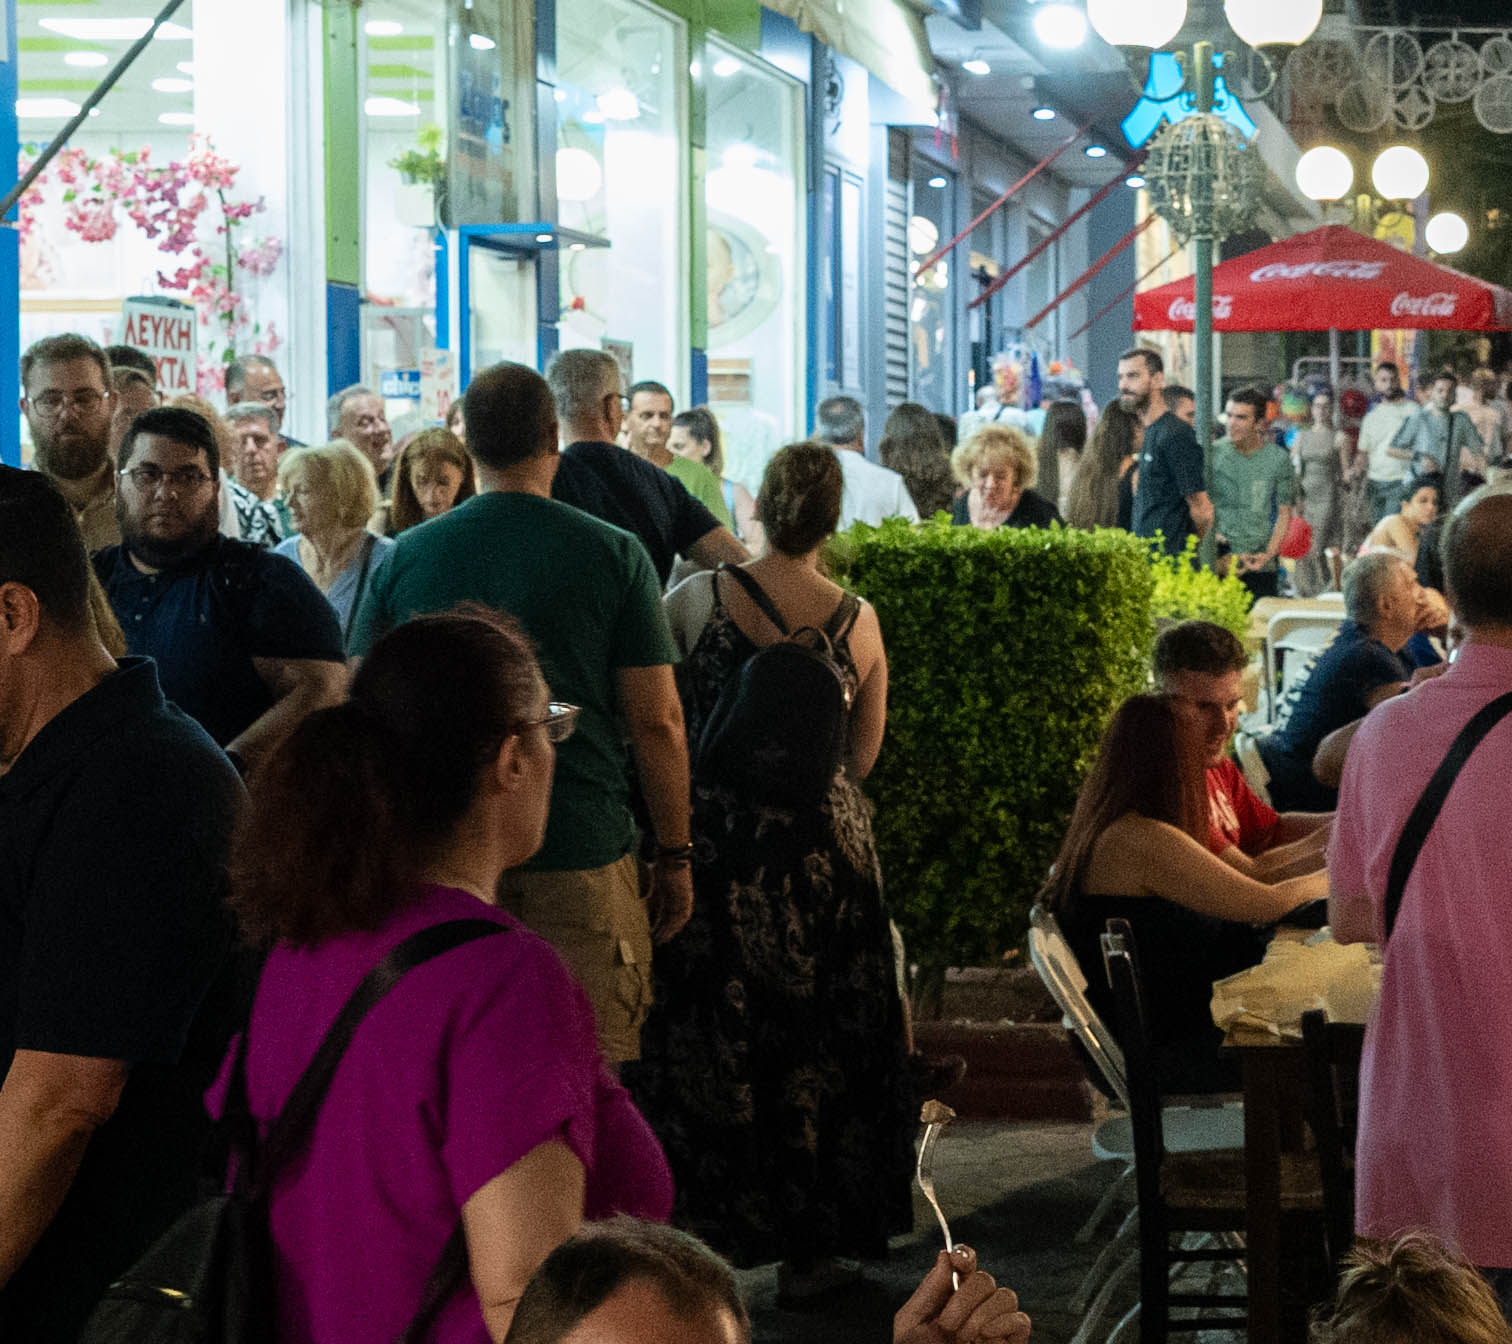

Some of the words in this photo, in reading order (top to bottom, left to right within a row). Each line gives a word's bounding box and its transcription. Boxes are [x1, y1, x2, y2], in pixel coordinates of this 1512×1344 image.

[1249, 259, 1386, 283] Coca-Cola
[1390, 291, 1458, 318] Coca-Cola
[124, 311, 192, 352] ΛΕΥΚΗ
[151, 355, 190, 390] ΧΤΑ
